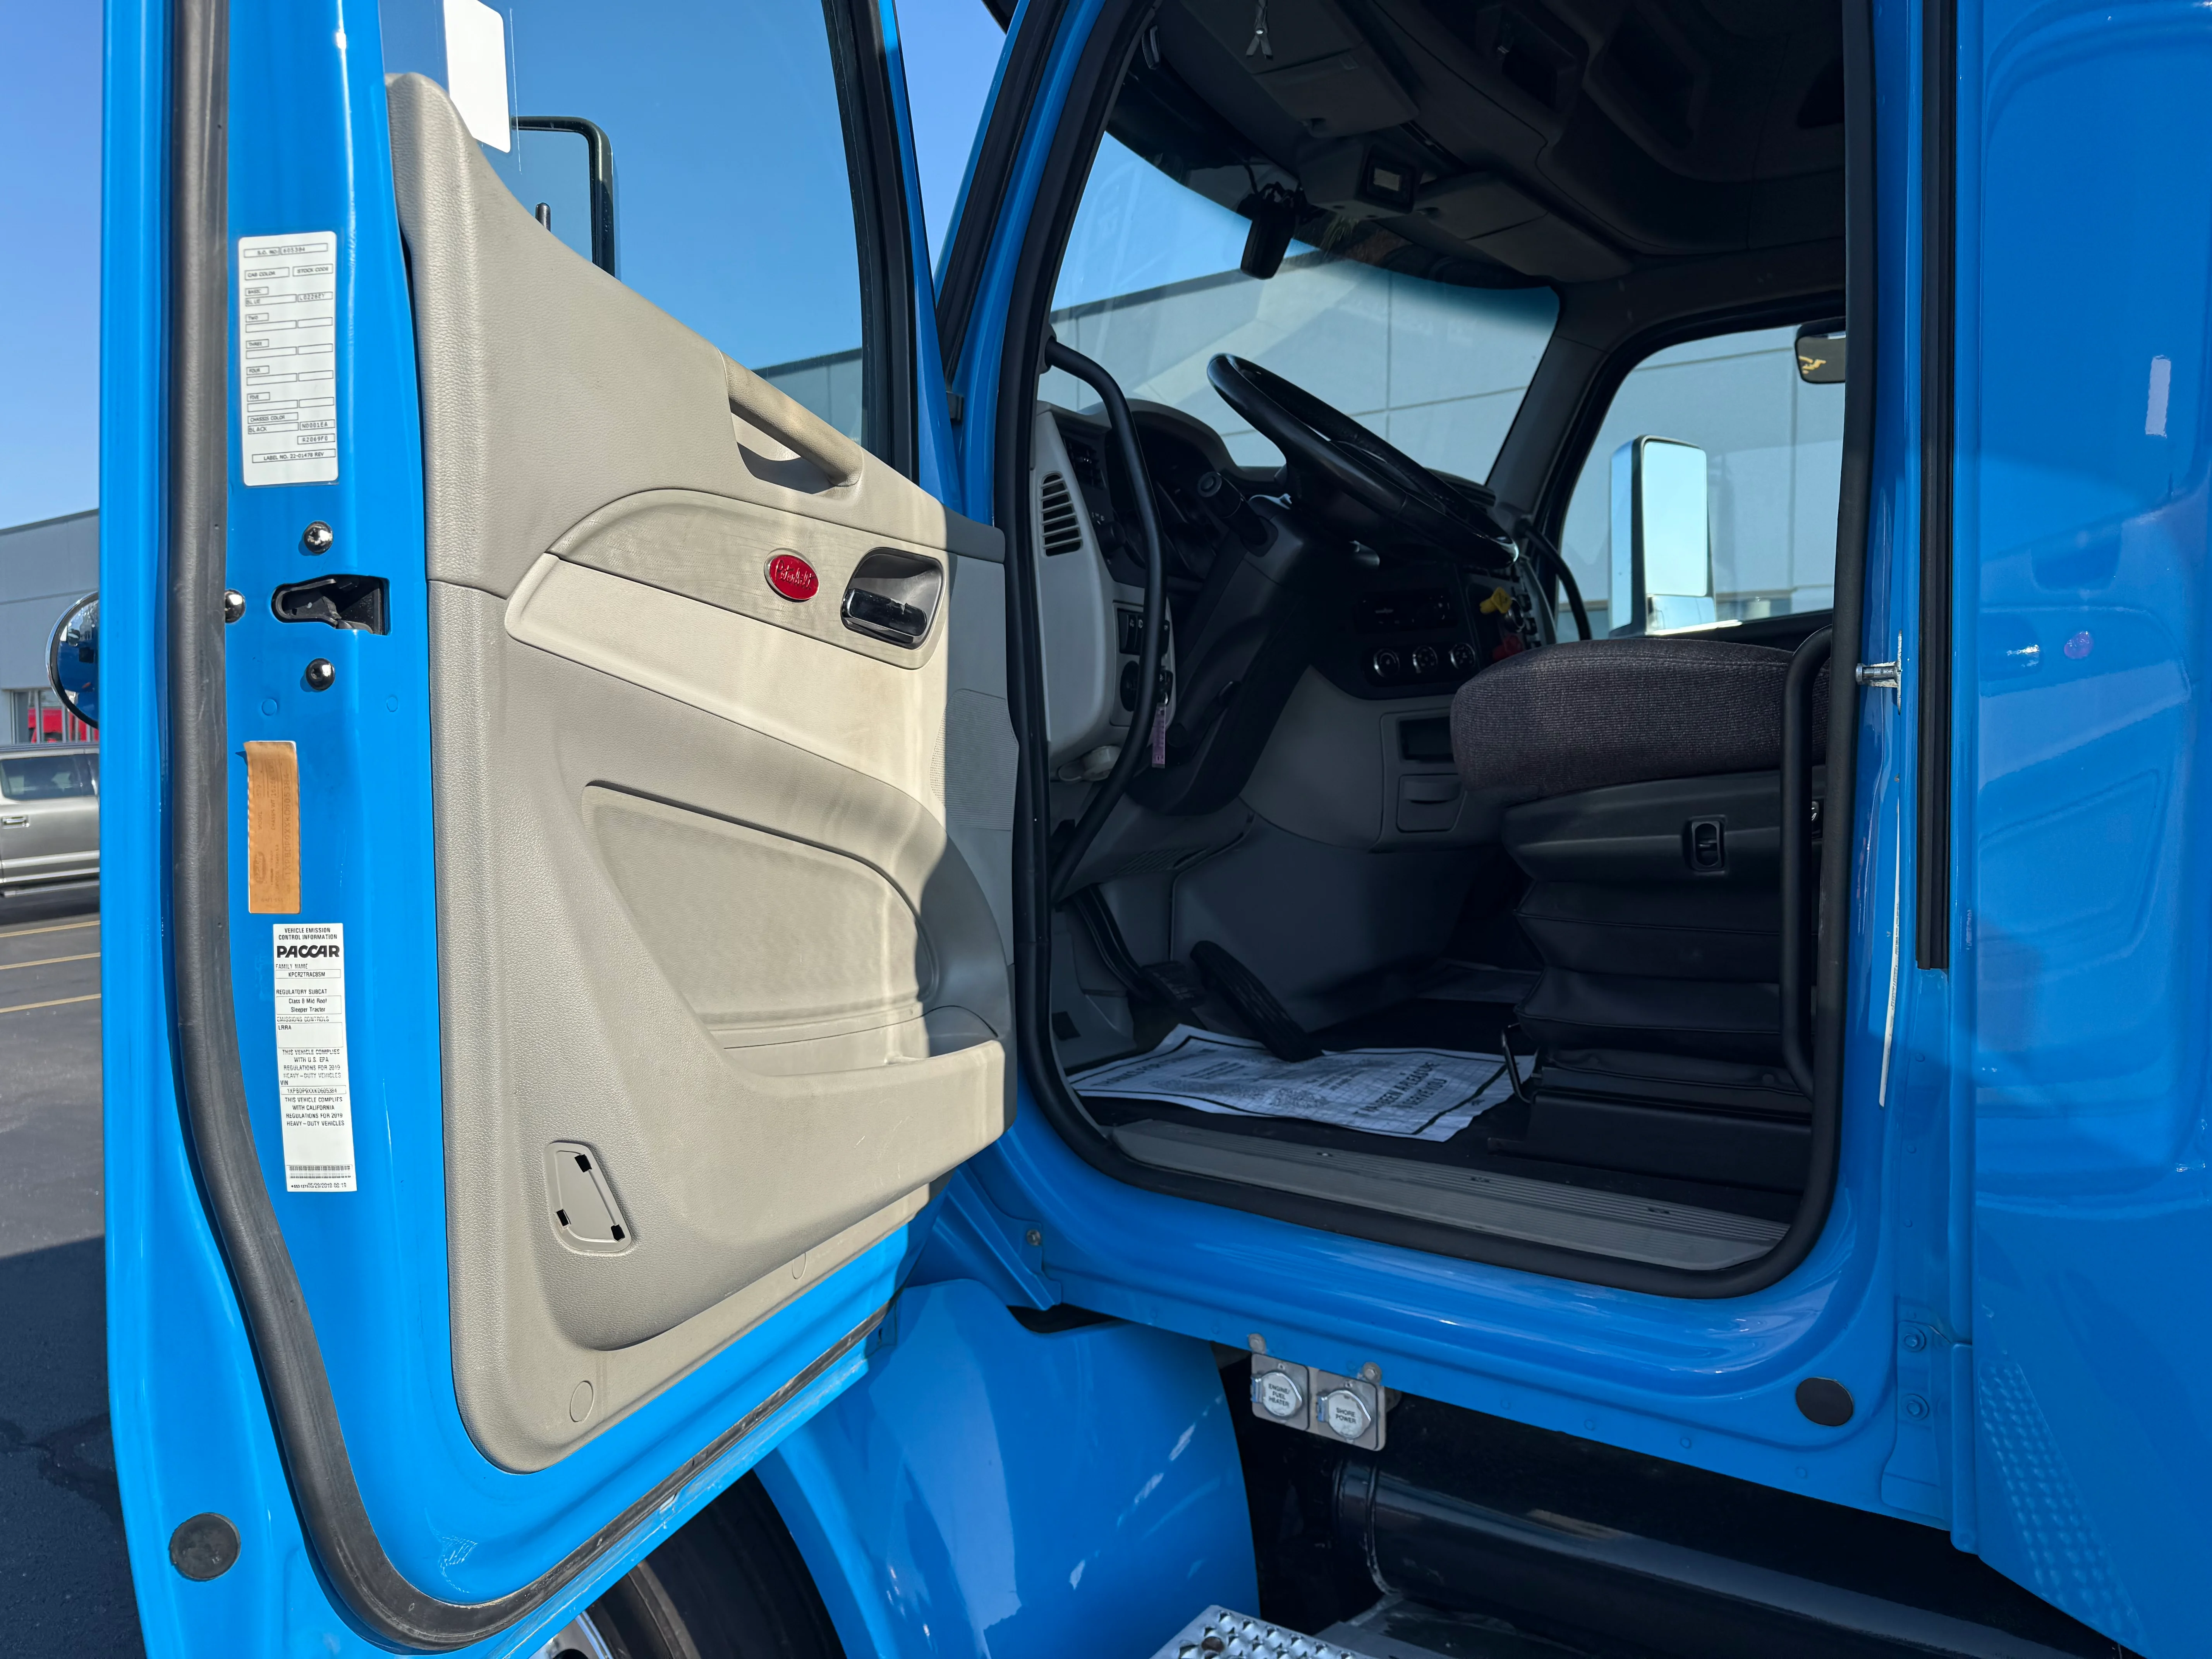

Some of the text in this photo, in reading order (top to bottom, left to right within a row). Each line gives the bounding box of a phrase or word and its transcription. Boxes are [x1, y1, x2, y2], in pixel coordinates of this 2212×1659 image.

[775, 559, 816, 590] Peterbilt
[270, 799, 275, 808] WT
[277, 945, 340, 958] PACCAR
[1336, 1407, 1355, 1417] SHORE
[1336, 1414, 1356, 1424] POWER
